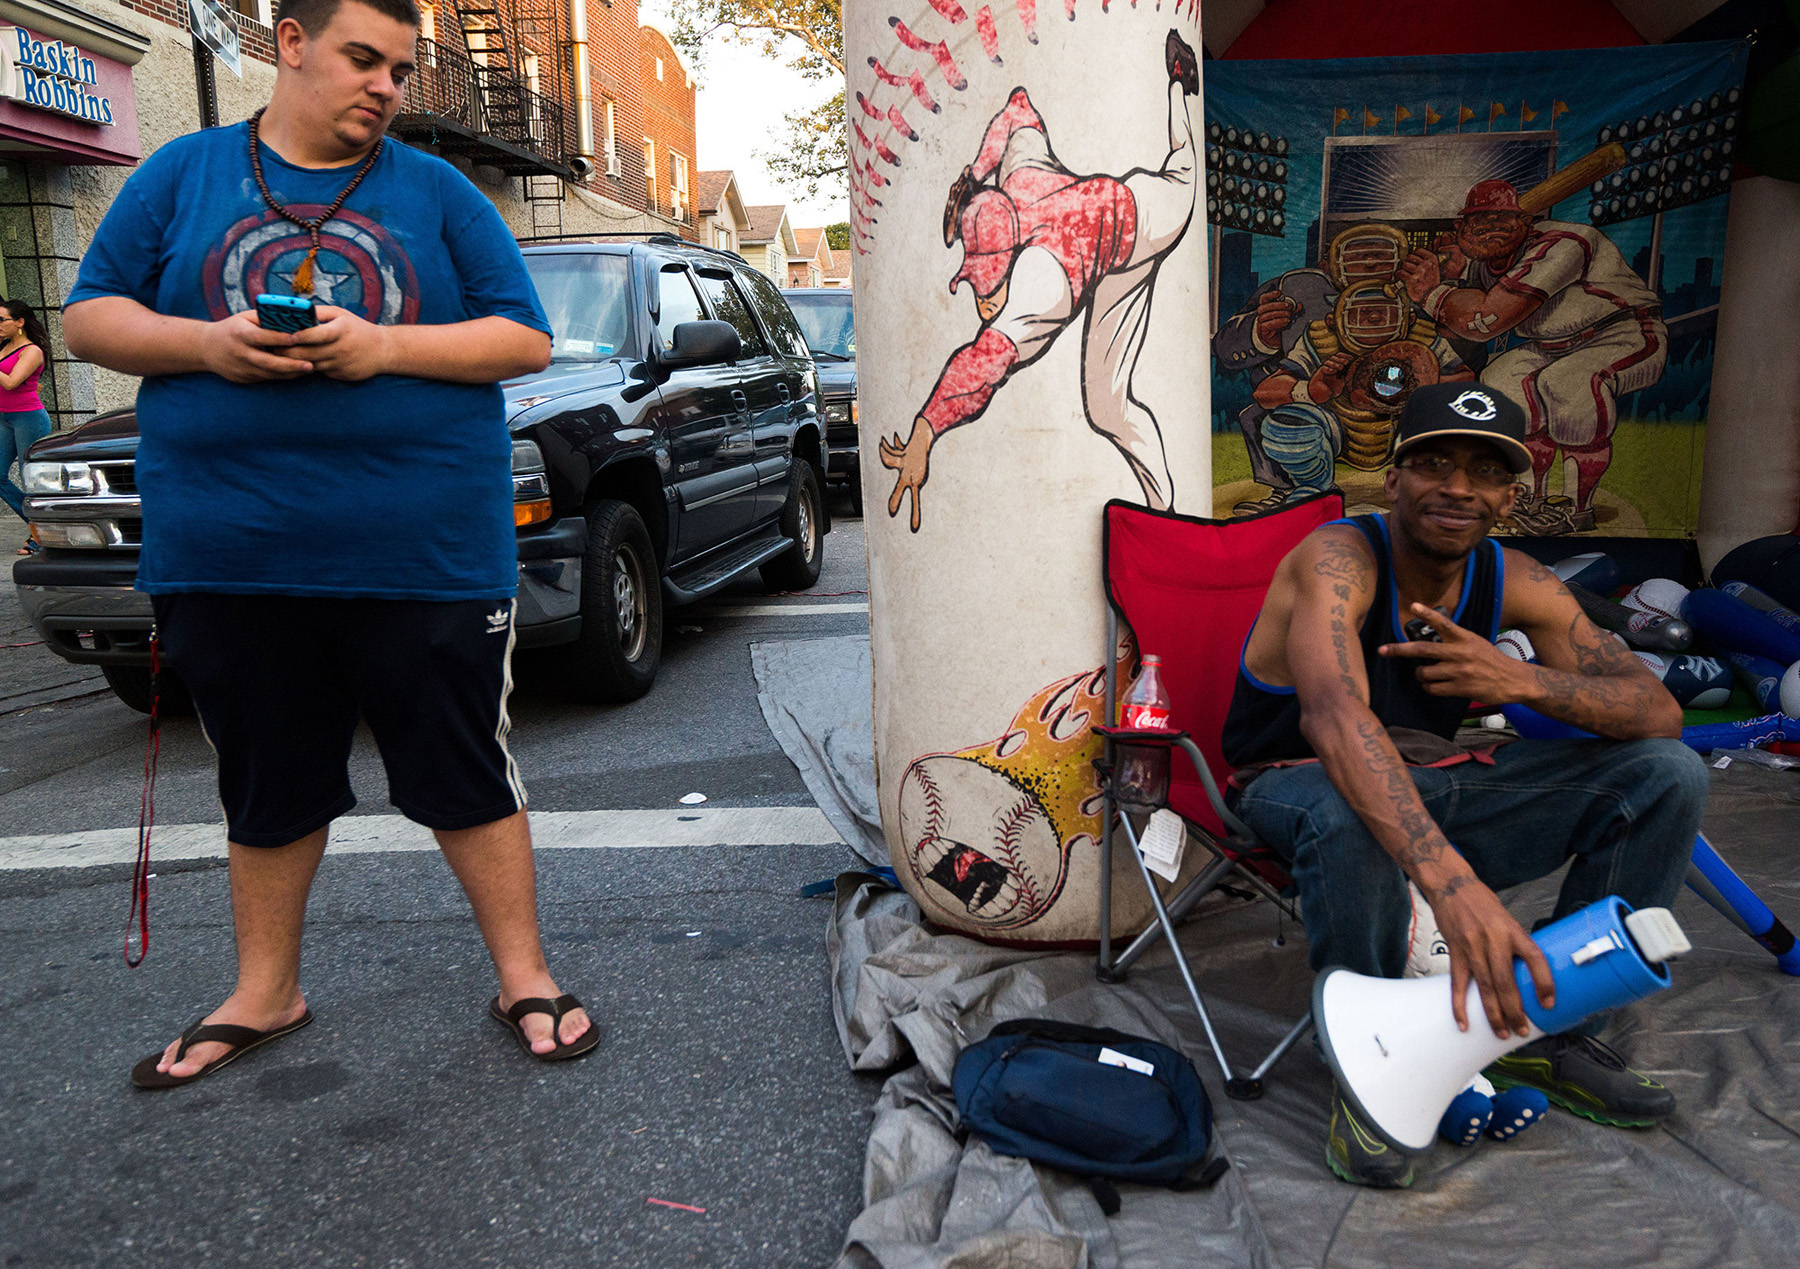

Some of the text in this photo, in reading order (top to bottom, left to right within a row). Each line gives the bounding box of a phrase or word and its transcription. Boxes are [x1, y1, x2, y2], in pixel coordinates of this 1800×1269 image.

[15, 26, 98, 86] Baskin
[202, 5, 235, 53] ONE WAY
[21, 66, 113, 124] Robbins
